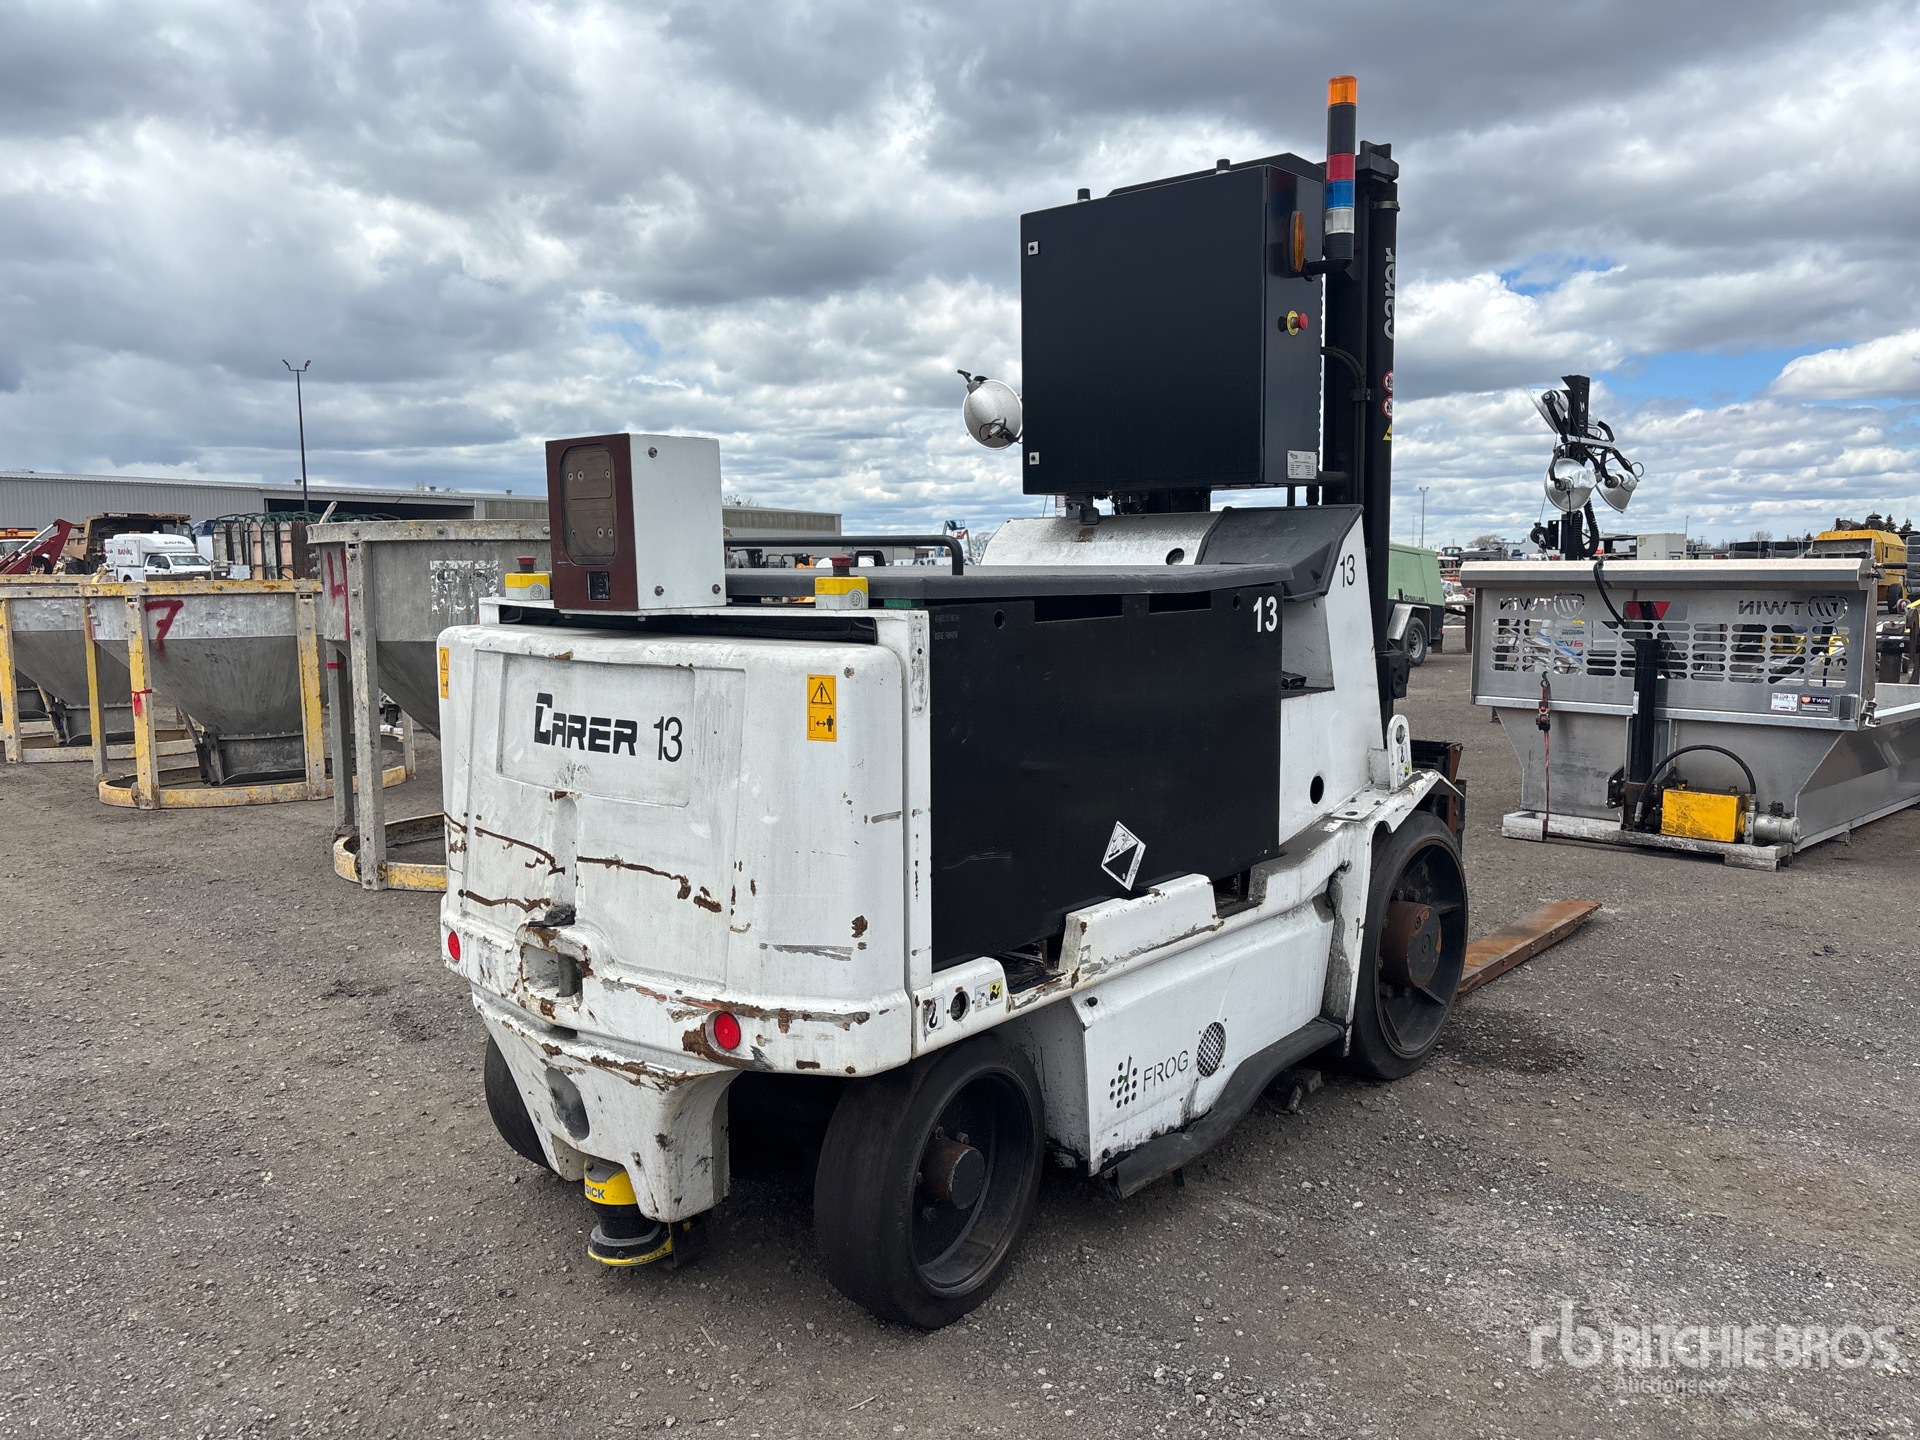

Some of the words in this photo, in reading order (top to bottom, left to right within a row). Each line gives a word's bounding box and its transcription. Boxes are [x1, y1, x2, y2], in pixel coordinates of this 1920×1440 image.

[1384, 248, 1396, 339] carer
[1340, 554, 1356, 588] 13
[144, 600, 184, 661] 7
[1253, 596, 1278, 633] 13
[534, 692, 638, 757] CARER
[653, 716, 683, 762] 13
[1143, 1050, 1188, 1092] FROG
[586, 1183, 605, 1199] SICK
